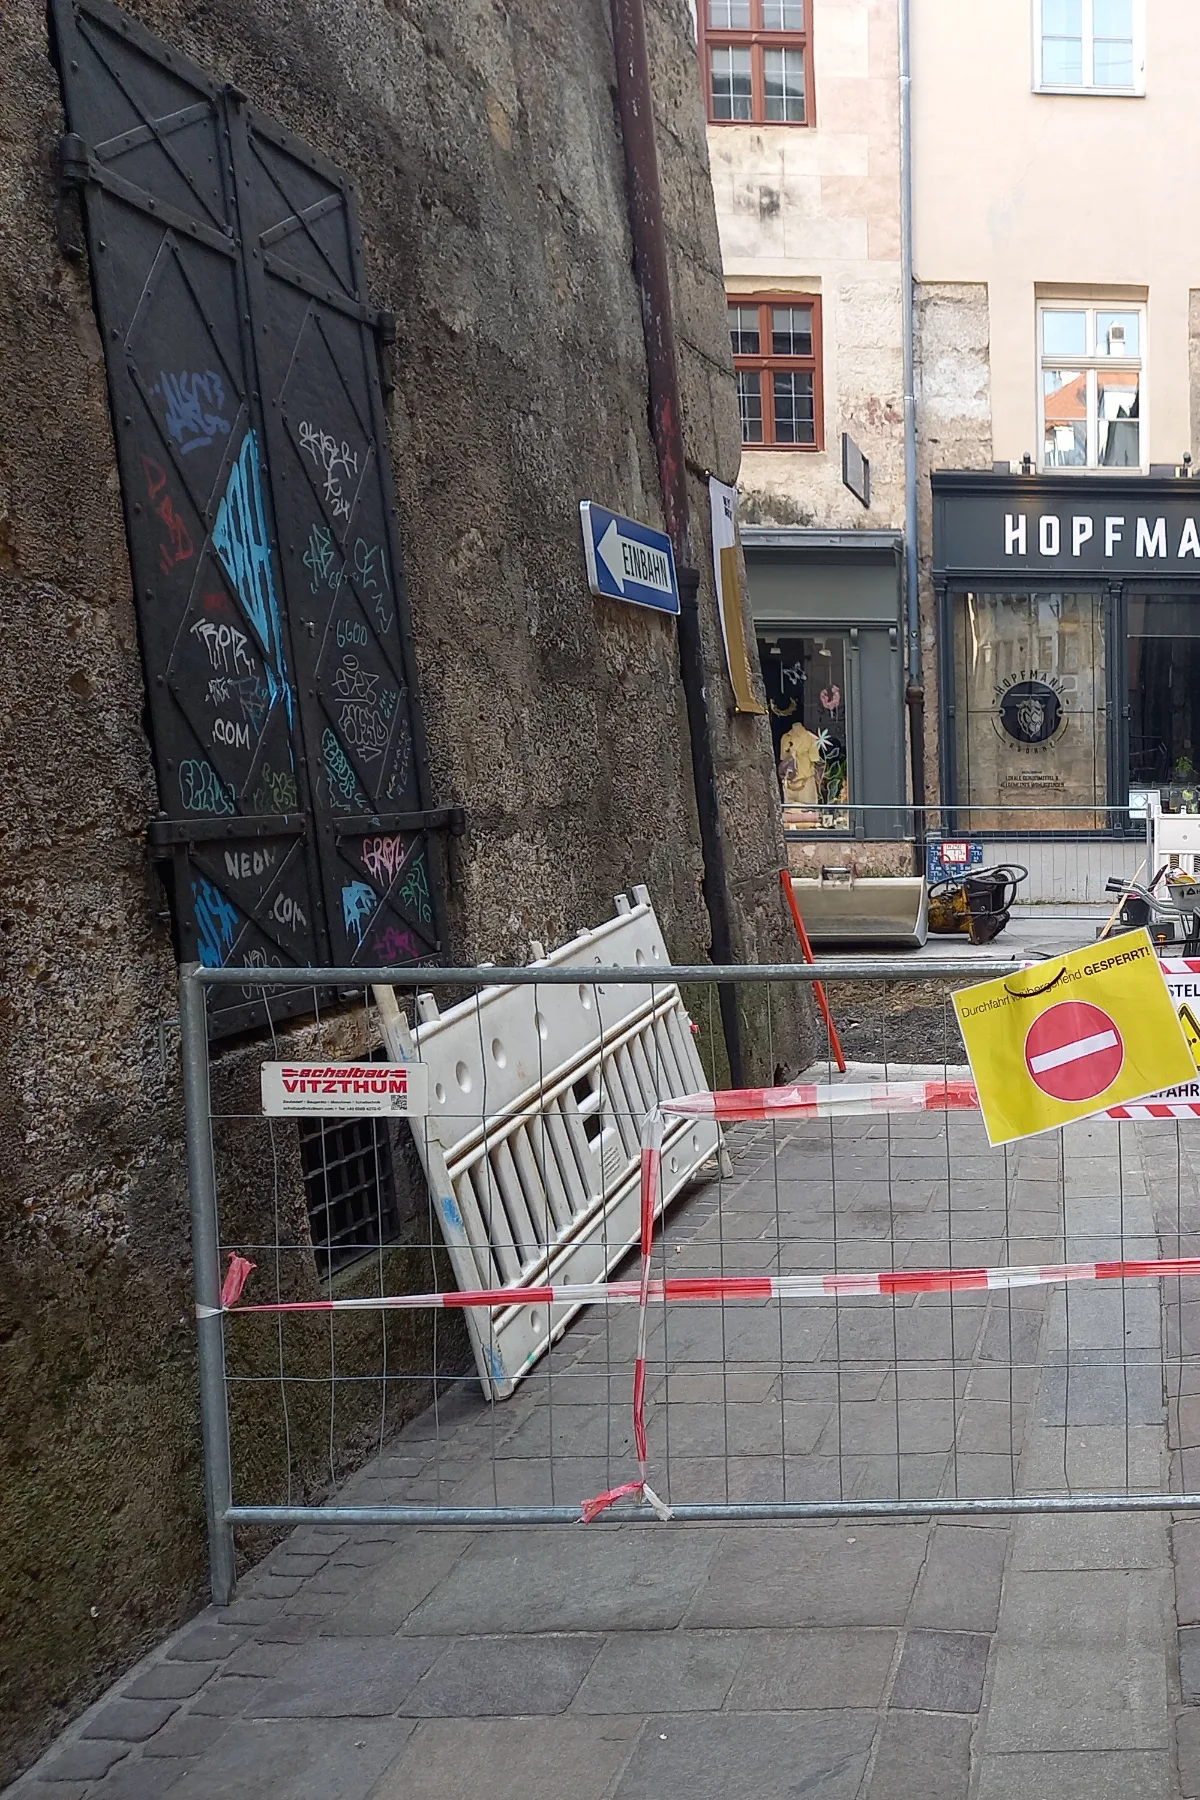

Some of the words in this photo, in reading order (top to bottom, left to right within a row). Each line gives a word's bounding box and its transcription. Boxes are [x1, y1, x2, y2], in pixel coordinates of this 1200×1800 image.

[621, 542, 669, 588] EINBAHN
[993, 669, 1066, 696] HOPFMANN
[961, 995, 1011, 1019] Durchfahrt
[1083, 946, 1151, 976] GESPERRT!
[298, 1067, 391, 1079] schalbau
[282, 1080, 408, 1094] VITZTHUM
